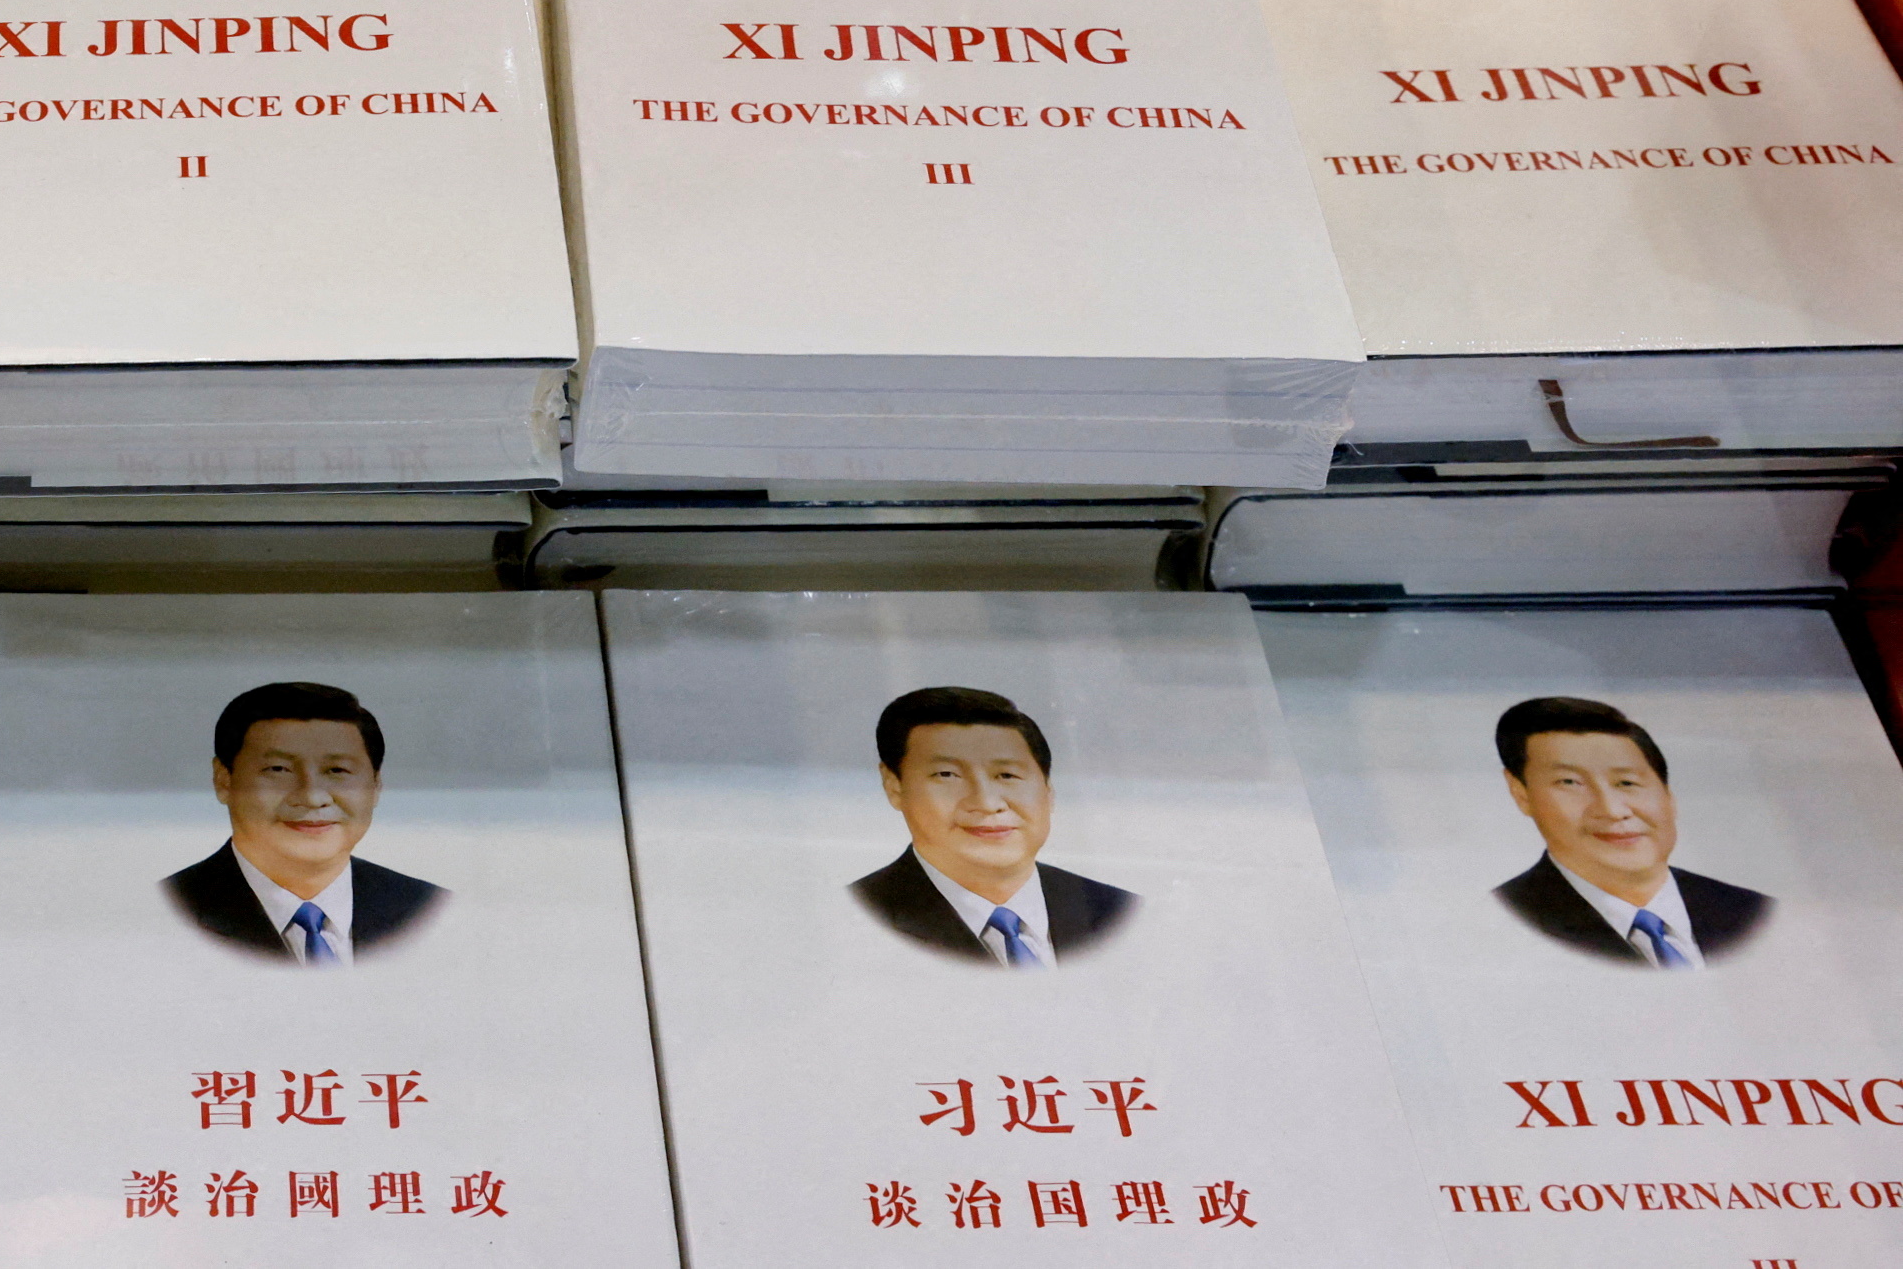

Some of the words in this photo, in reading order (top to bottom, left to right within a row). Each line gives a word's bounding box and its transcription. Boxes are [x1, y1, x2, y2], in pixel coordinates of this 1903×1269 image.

[86, 13, 394, 58] JINPING
[720, 22, 805, 61] XI
[823, 24, 1130, 65] JINPING
[294, 94, 352, 117] OF
[360, 91, 499, 116] CHINA
[1380, 69, 1463, 104] XI
[1480, 61, 1763, 102] JINPING
[632, 98, 720, 123] THE
[729, 101, 1029, 128] GOVERNANCE
[1039, 106, 1096, 129] OF
[1105, 106, 1247, 131] CHINA
[177, 155, 209, 179] II
[924, 162, 976, 185] III
[1324, 154, 1408, 176] THE
[1416, 147, 1696, 174] GOVERNANCE
[1701, 145, 1754, 167] OF
[1760, 143, 1898, 167] CHINA
[190, 1068, 430, 1130] 習近平
[918, 1074, 1159, 1138] 习近平
[1504, 1079, 1597, 1129] XI
[1615, 1077, 1903, 1127] JINPING
[125, 1169, 511, 1219] 談治國理政
[865, 1179, 1259, 1230] 谈治国理政
[1439, 1184, 1531, 1213] THE
[1540, 1181, 1843, 1213] GOVERNANCE
[1849, 1181, 1903, 1210] OF
